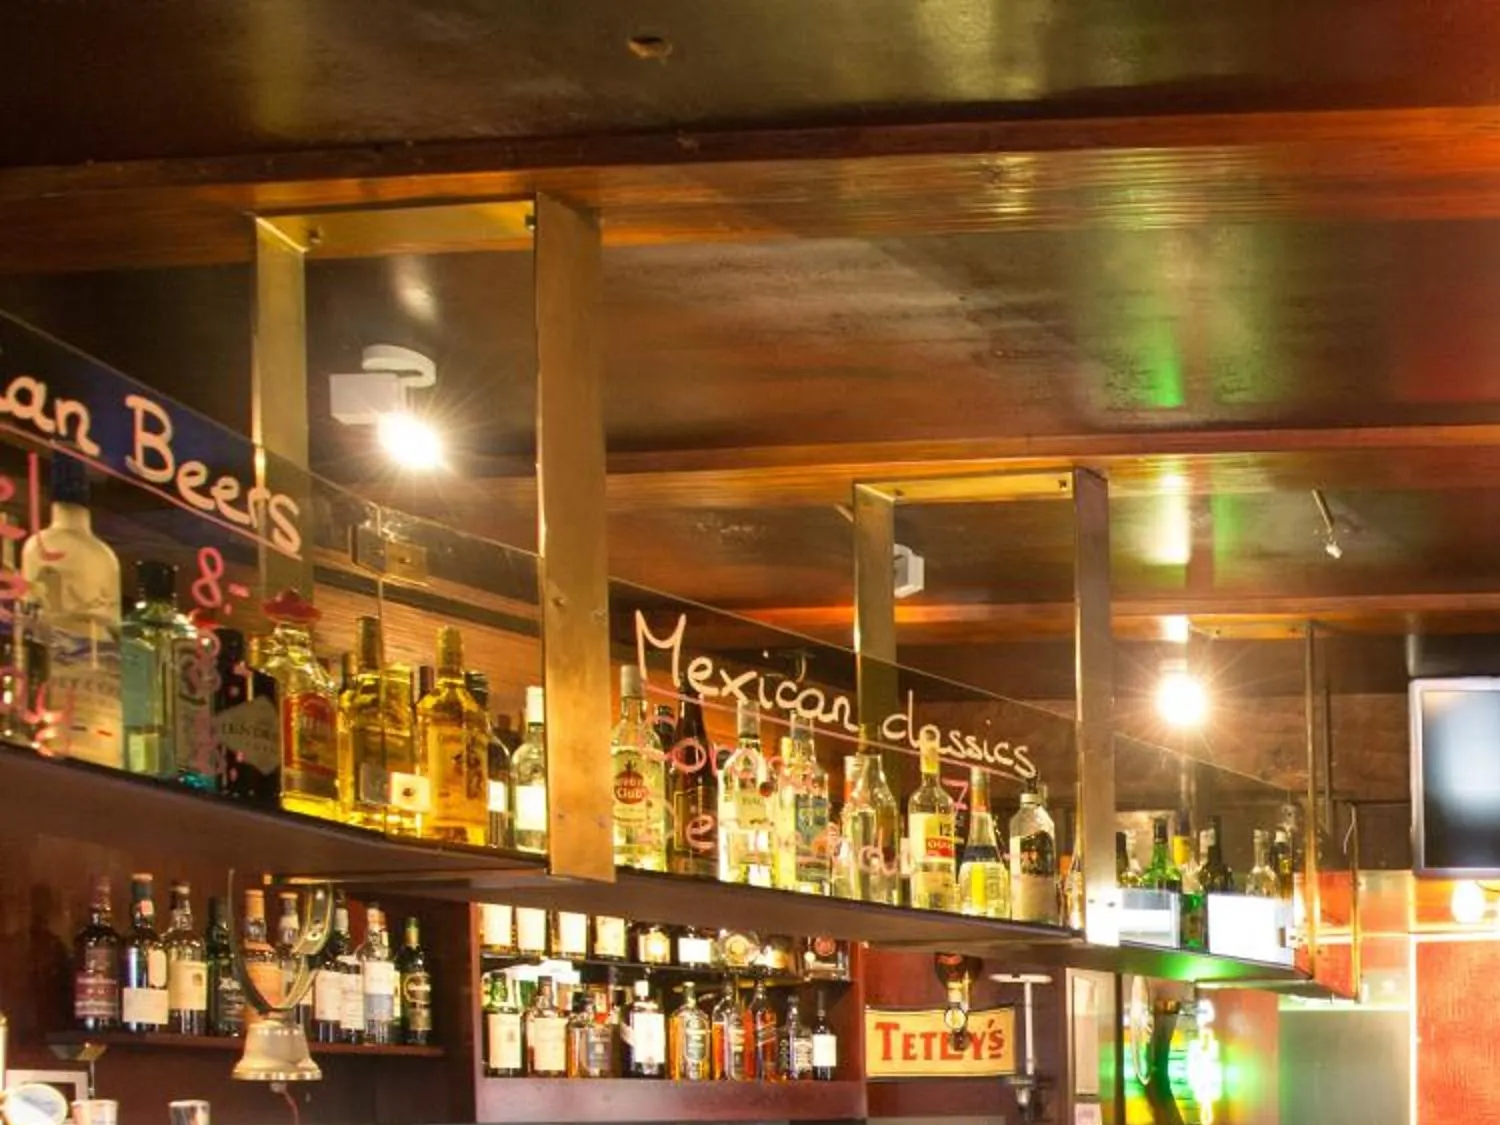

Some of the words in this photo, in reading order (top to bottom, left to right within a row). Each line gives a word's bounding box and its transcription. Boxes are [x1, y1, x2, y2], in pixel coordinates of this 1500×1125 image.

[0, 374, 101, 458] an
[124, 392, 302, 553] Beers
[635, 608, 859, 733] Mexican
[882, 689, 1038, 779] classics
